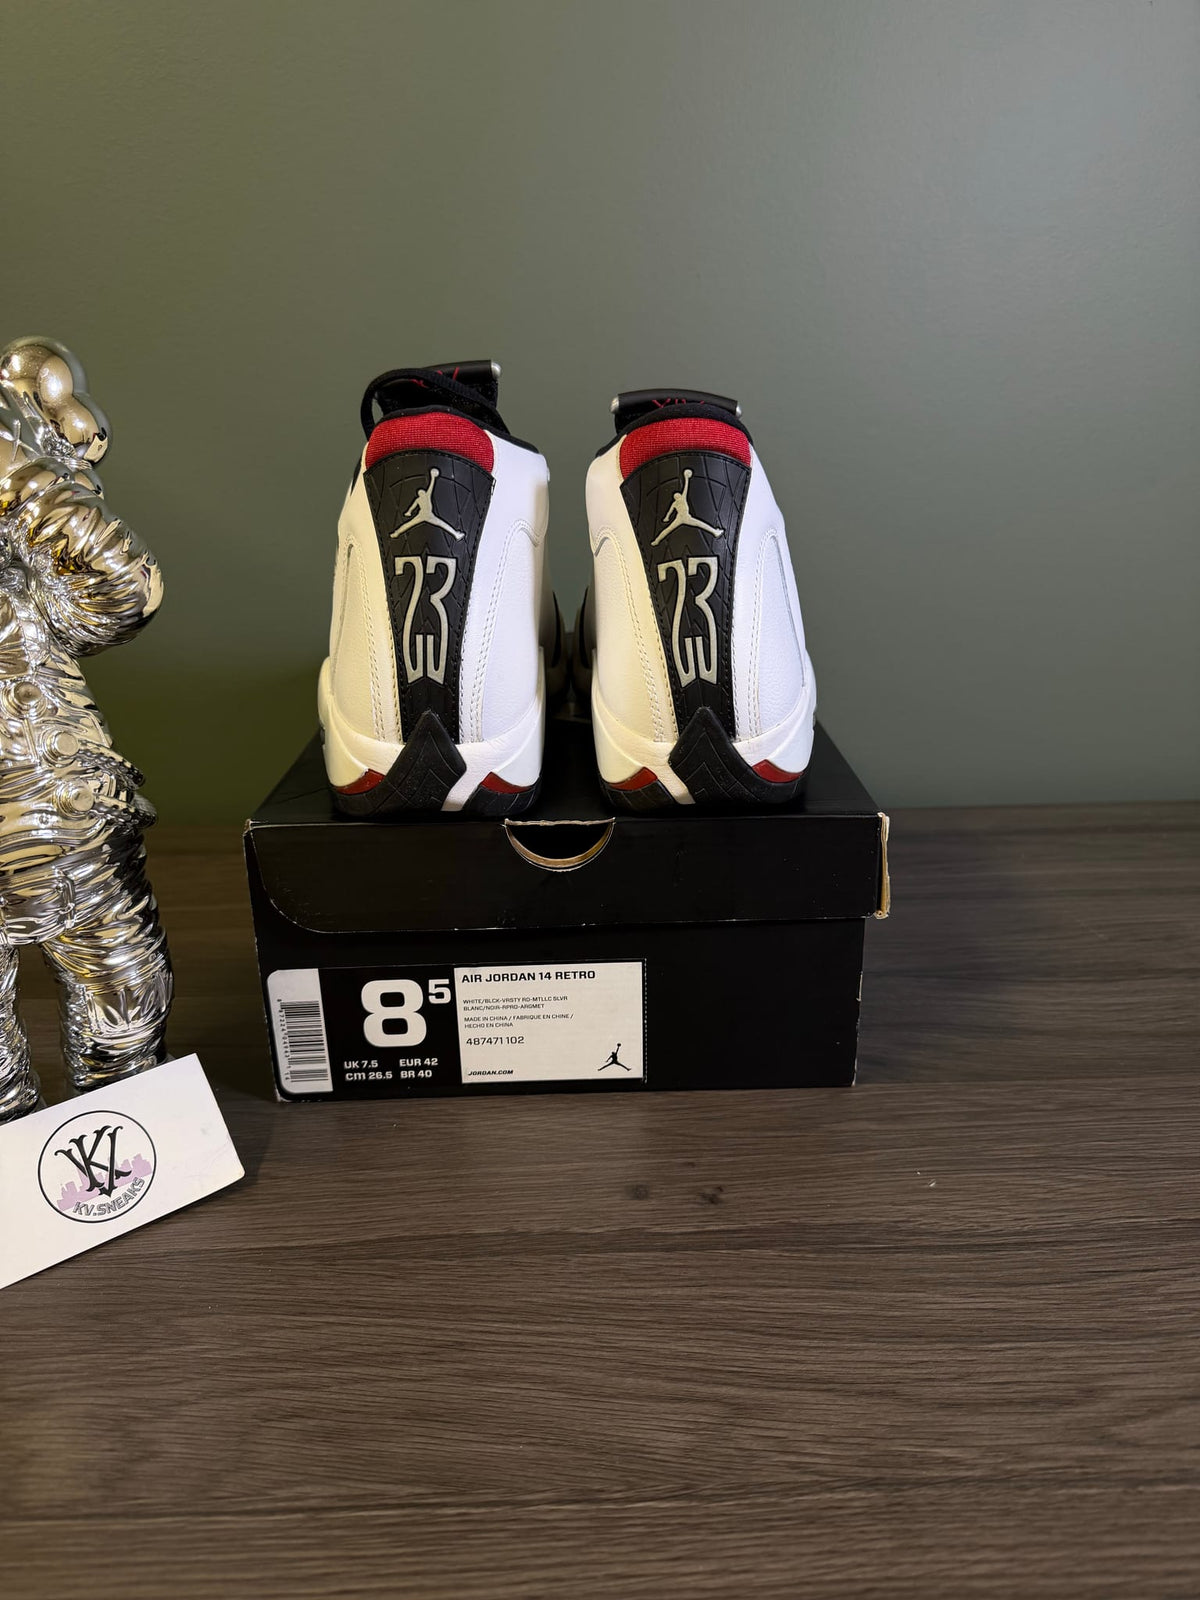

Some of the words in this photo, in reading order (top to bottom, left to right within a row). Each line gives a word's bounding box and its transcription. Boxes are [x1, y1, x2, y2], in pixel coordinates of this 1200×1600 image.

[394, 555, 457, 685] 23
[657, 556, 719, 688] 23
[462, 974, 482, 983] AIR
[485, 972, 536, 982] JORDAN
[539, 972, 552, 980] 14
[555, 970, 596, 980] RETRO
[361, 979, 427, 1047] 8
[428, 978, 452, 1004] 5
[344, 1061, 359, 1069] UK
[361, 1060, 378, 1068] 7.5
[399, 1058, 421, 1067] EUR
[423, 1058, 439, 1066] 42
[368, 1071, 393, 1079] 26.5
[400, 1070, 416, 1078] BR
[417, 1069, 433, 1077] 40
[72, 1176, 145, 1216] KV.SNEAKS
